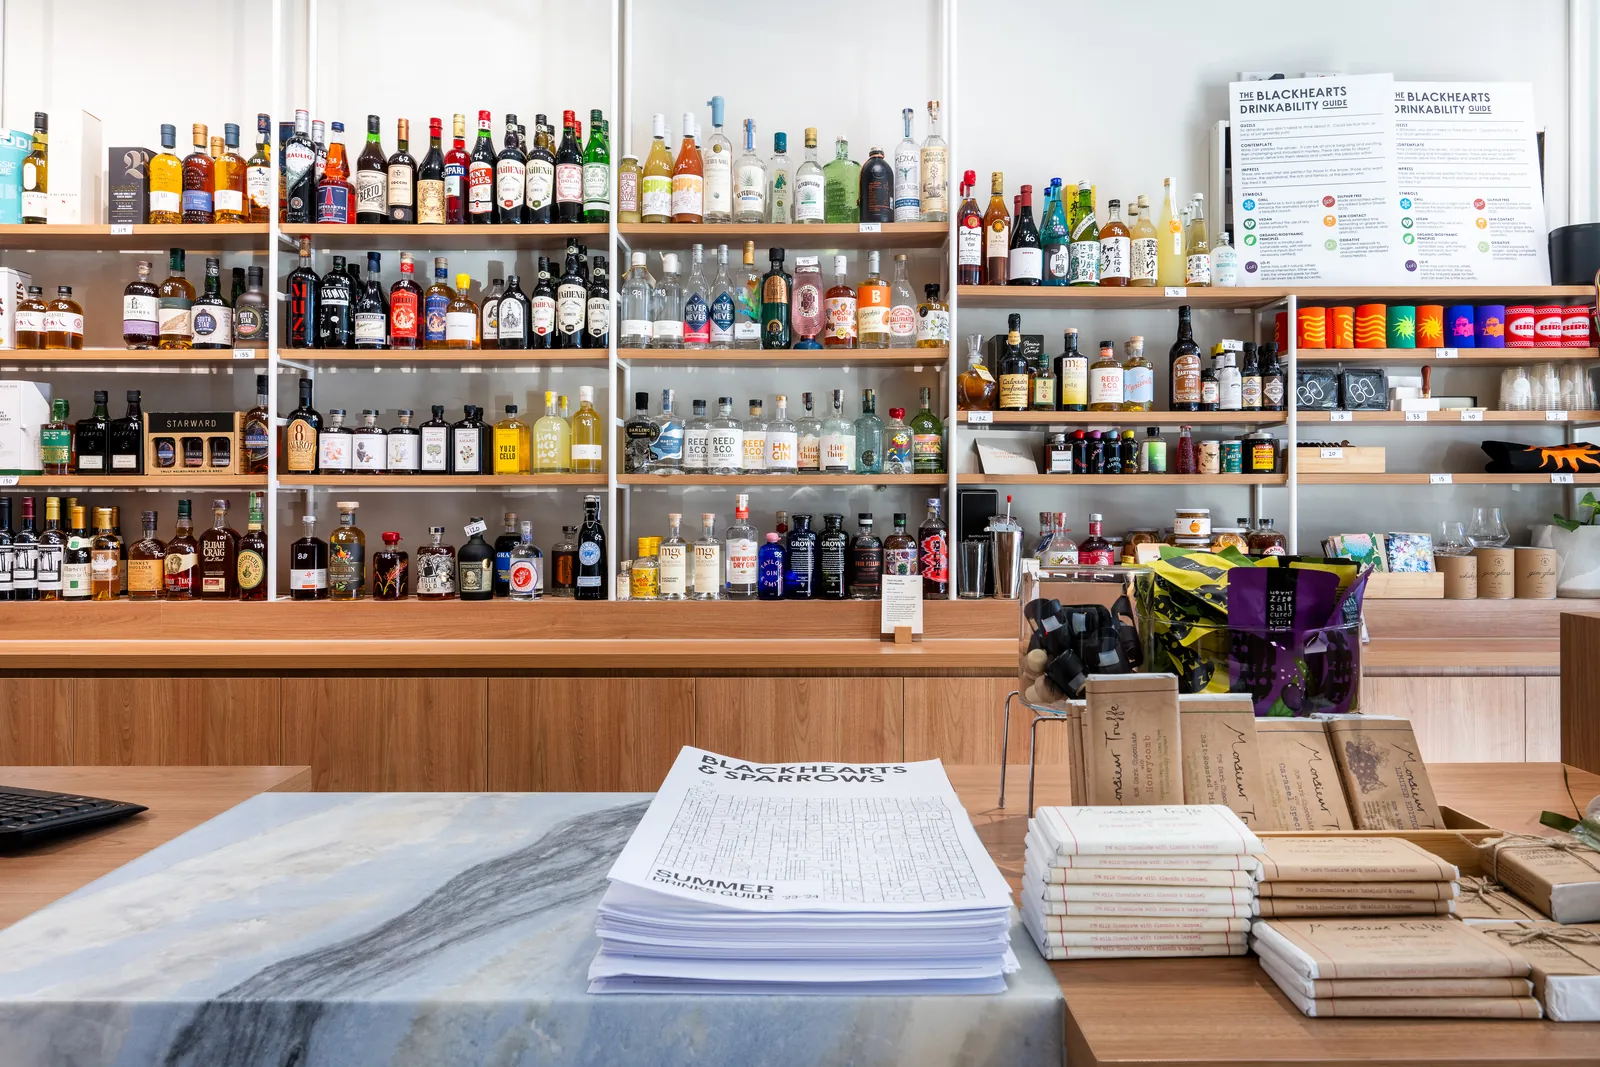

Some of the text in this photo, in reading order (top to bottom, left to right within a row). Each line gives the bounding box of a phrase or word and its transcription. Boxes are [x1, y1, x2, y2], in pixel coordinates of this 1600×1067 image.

[1239, 86, 1347, 101] THE BLACKHEARTS
[1394, 91, 1491, 102] HE BLACKHEARTS
[1240, 99, 1348, 114] DRINKABILITY GUIDE
[398, 155, 410, 163] 62
[359, 184, 380, 203] BERTO
[632, 289, 643, 299] 99
[871, 289, 881, 304] B
[686, 304, 707, 312] NEVER
[713, 304, 733, 312] NEVER
[932, 302, 940, 310] 70
[166, 419, 217, 428] STARWARD
[713, 437, 735, 445] REED
[772, 442, 791, 451] HM
[714, 445, 734, 453] &CO.
[499, 452, 516, 460] CELLO
[772, 452, 791, 460] GIN
[469, 526, 480, 534] 120
[203, 541, 225, 549] ELIJAH
[203, 548, 225, 557] CRAIG
[1270, 603, 1292, 611] salt
[1270, 610, 1292, 618] cured
[1104, 703, 1125, 806] onsieur Truffe
[1131, 732, 1139, 766] Chocolate
[701, 754, 907, 774] BLACKHEARTS
[1143, 735, 1154, 793] Honeycomb
[1221, 721, 1249, 802] Monsieur
[698, 764, 884, 783] & SPARROWS
[1296, 740, 1332, 816] Monsieur
[1278, 762, 1295, 802] Caramel
[1391, 743, 1428, 817] Monsieur
[1394, 766, 1410, 798] LIMITED
[655, 869, 774, 893] SUMMER
[652, 876, 716, 894] DRINKS
[720, 890, 775, 900] GUIDE
